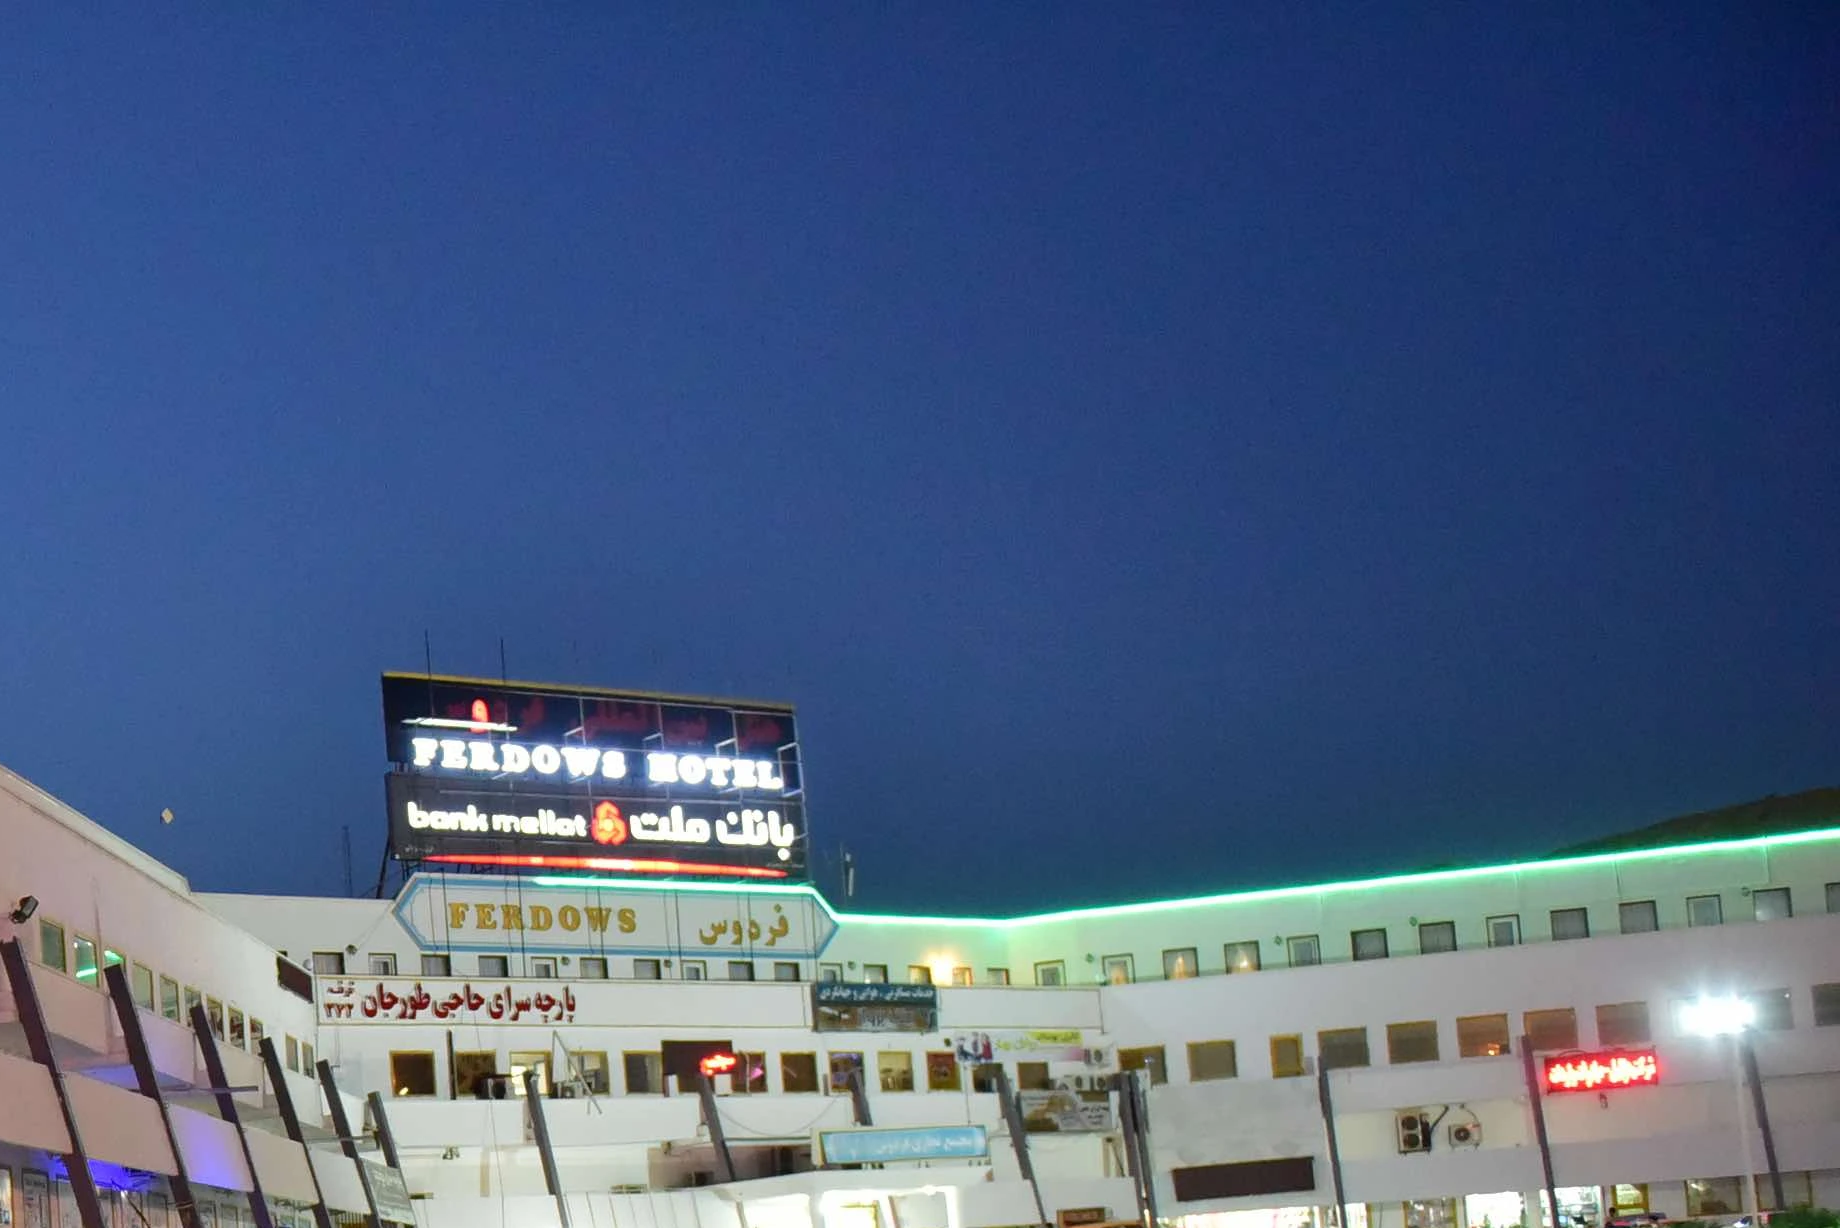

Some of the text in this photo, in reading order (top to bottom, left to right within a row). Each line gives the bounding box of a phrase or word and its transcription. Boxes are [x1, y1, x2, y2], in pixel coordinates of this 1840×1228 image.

[411, 737, 785, 790] FERDOWS HOTEL
[407, 801, 587, 837] bank mellat
[629, 805, 795, 861] بانک ملت
[447, 901, 637, 934] FERDOWS
[698, 903, 790, 947] فردوس
[432, 982, 486, 1020] حاجی
